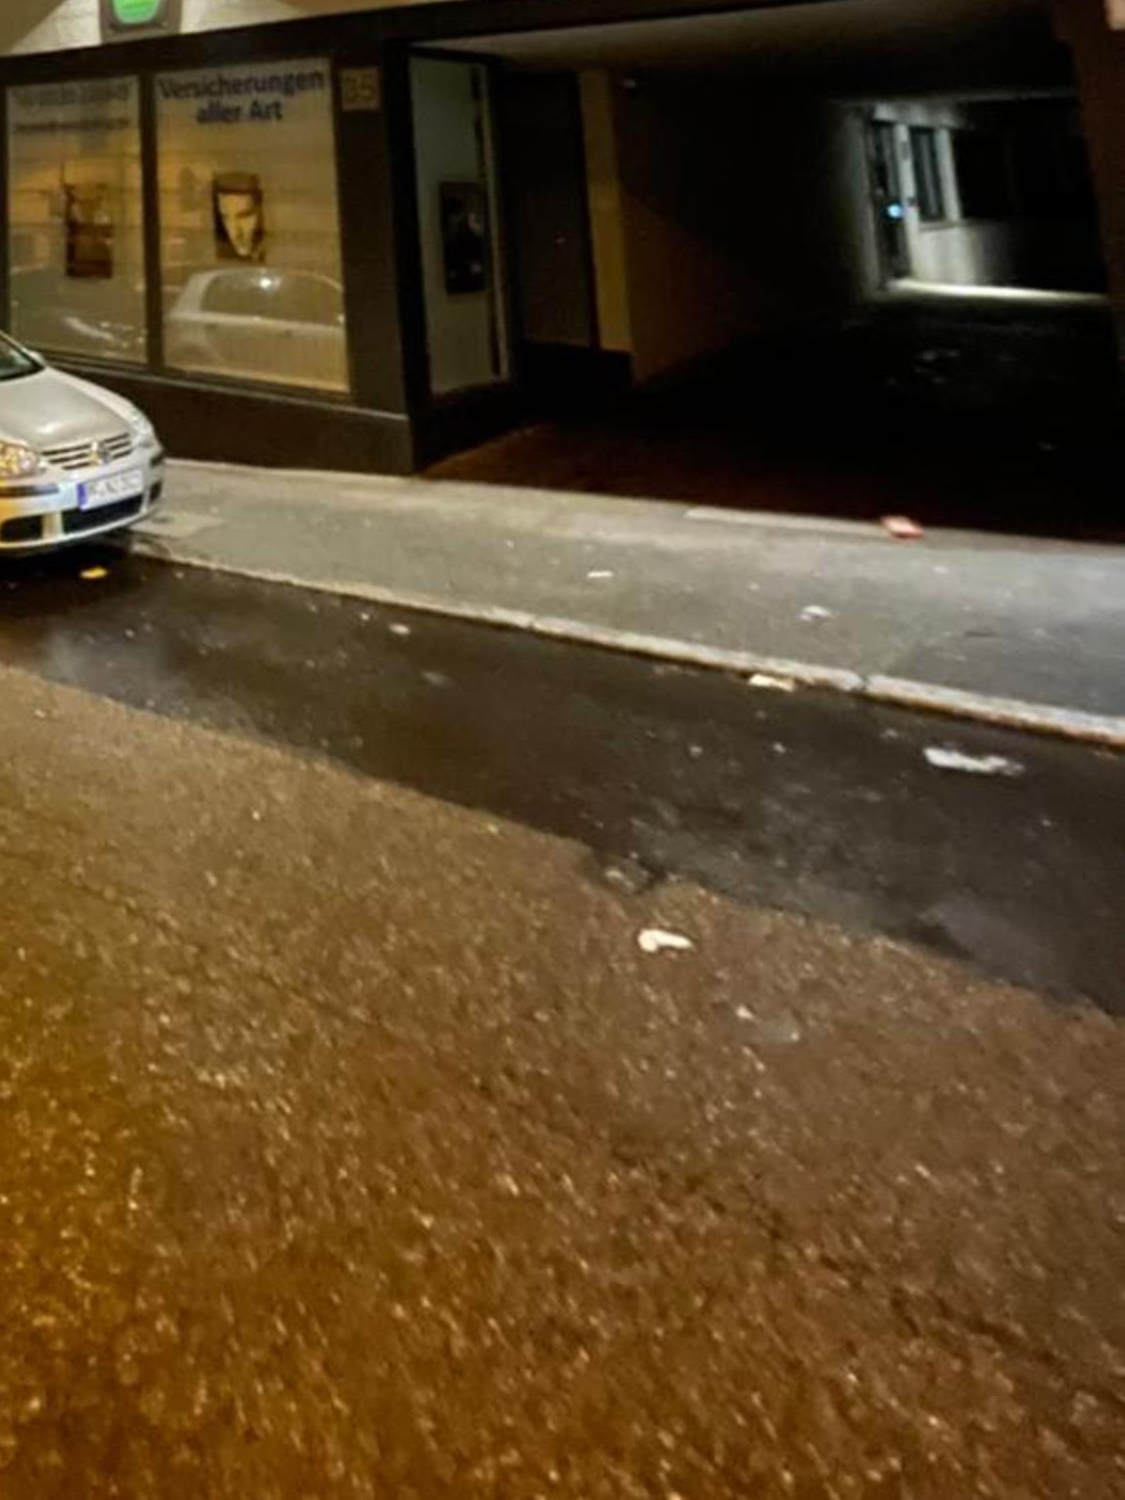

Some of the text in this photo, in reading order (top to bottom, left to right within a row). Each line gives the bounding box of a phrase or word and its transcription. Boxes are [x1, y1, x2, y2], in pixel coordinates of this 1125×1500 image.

[159, 70, 325, 99] Versicherungen
[196, 98, 283, 124] aller Art
